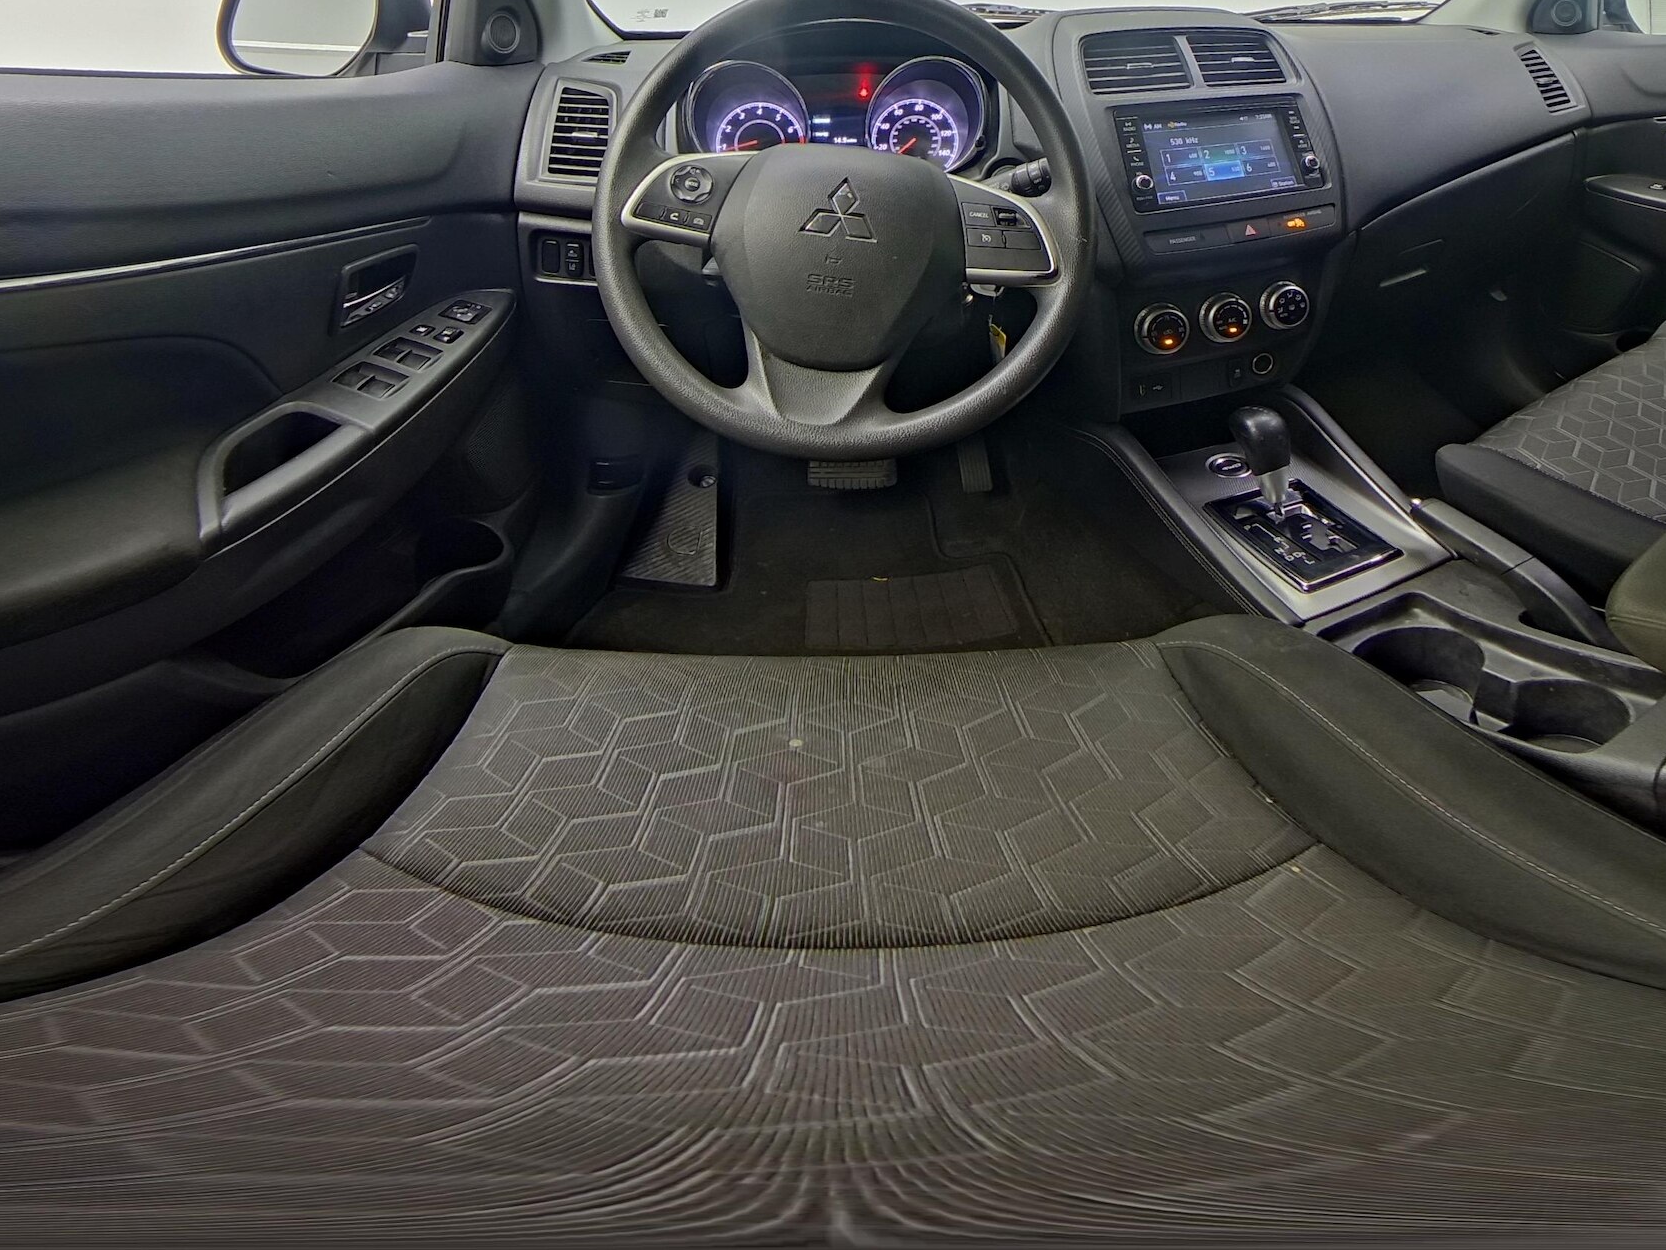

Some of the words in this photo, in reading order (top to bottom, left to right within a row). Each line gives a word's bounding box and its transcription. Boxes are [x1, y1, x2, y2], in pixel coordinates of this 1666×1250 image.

[1204, 150, 1211, 159] 2
[1241, 146, 1247, 155] 3
[1166, 154, 1171, 162] 1
[1209, 168, 1215, 177] 5
[1247, 164, 1252, 172] 6
[1170, 172, 1176, 181] 4
[1169, 236, 1196, 244] PASSENGER
[807, 274, 856, 289] SRS
[807, 285, 853, 297] AIRBAG
